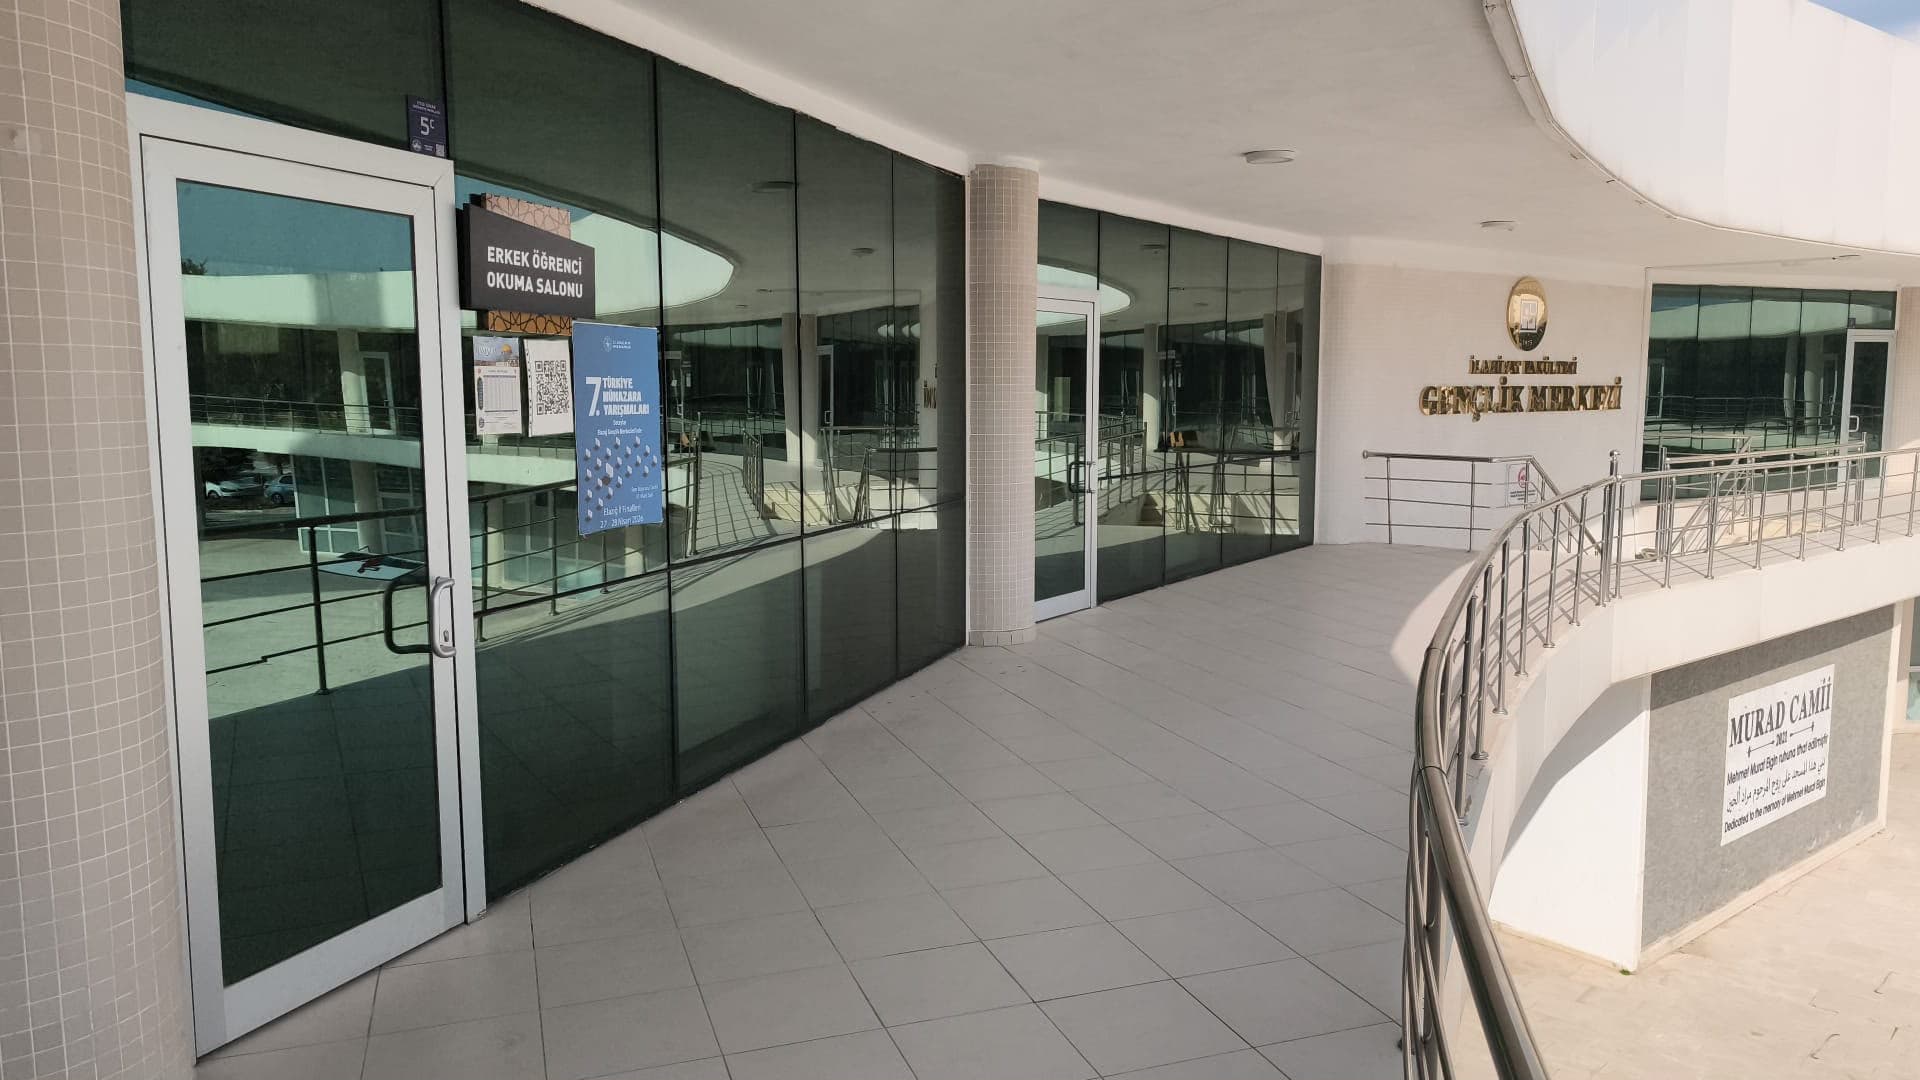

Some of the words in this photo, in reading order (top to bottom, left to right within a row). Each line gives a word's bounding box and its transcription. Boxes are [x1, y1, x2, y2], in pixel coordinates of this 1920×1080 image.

[487, 246, 530, 268] ERKEK
[532, 249, 582, 275] ÖĞRENCİ
[486, 271, 534, 293] OKUMA
[536, 278, 583, 298] SALONU
[1468, 355, 1521, 374] İLAHİYAT
[1522, 356, 1577, 374] FAKÜLTESİ
[586, 376, 601, 416] 7.
[602, 375, 633, 389] TÜRKİYE
[1419, 376, 1525, 422] GENÇLİK
[1527, 376, 1623, 413] MERKEZİ
[1729, 700, 1785, 747] MURAD
[1789, 676, 1831, 724] CAMİİ
[1726, 764, 1749, 786] Mehmet
[1750, 758, 1765, 775] Murat
[1778, 745, 1796, 764] ruhuna
[1724, 812, 1748, 833] Dedicated
[1749, 810, 1754, 821] to
[1762, 798, 1780, 816] memory
[1781, 794, 1786, 806] of
[1786, 786, 1803, 803] Mehmet
